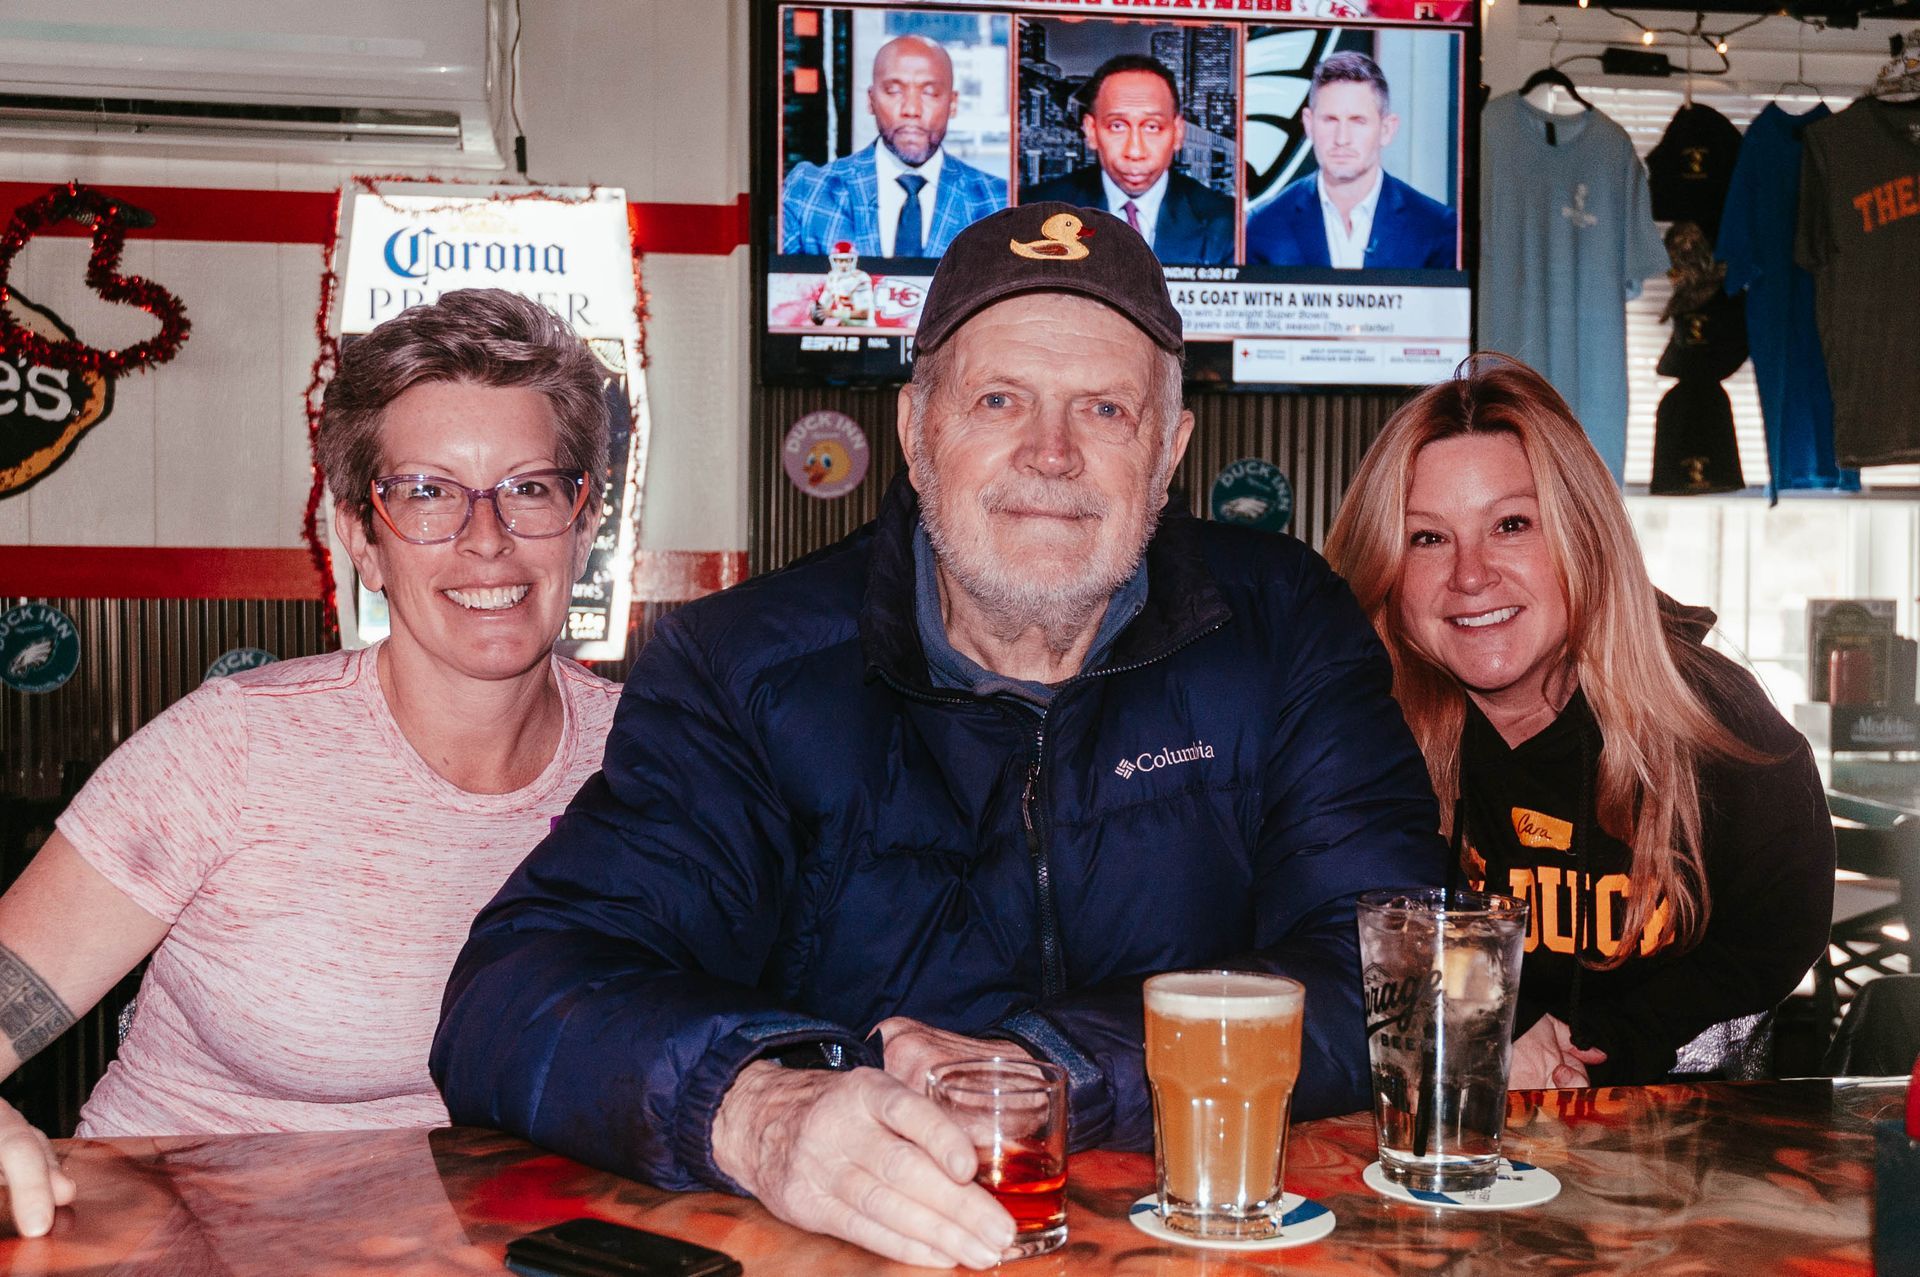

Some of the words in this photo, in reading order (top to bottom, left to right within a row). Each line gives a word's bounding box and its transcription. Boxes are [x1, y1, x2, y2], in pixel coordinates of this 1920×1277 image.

[383, 226, 567, 285] Corona
[1177, 290, 1195, 305] AS
[1200, 290, 1239, 305] GOAT
[1244, 291, 1283, 306] WITH
[1287, 292, 1297, 307] A
[1302, 292, 1332, 307] WIN
[1337, 293, 1403, 309] SUNDAY?
[1194, 321, 1221, 331] years
[1225, 309, 1264, 321] straight
[1266, 310, 1297, 321] Super
[1298, 311, 1329, 320] Bowls
[786, 413, 833, 453] DUCK
[836, 416, 867, 450] INN
[1221, 462, 1270, 488] DUCK
[40, 608, 72, 639] INN
[213, 652, 254, 677] UCK
[1136, 740, 1215, 772] Columbia
[1517, 813, 1552, 839] Cara
